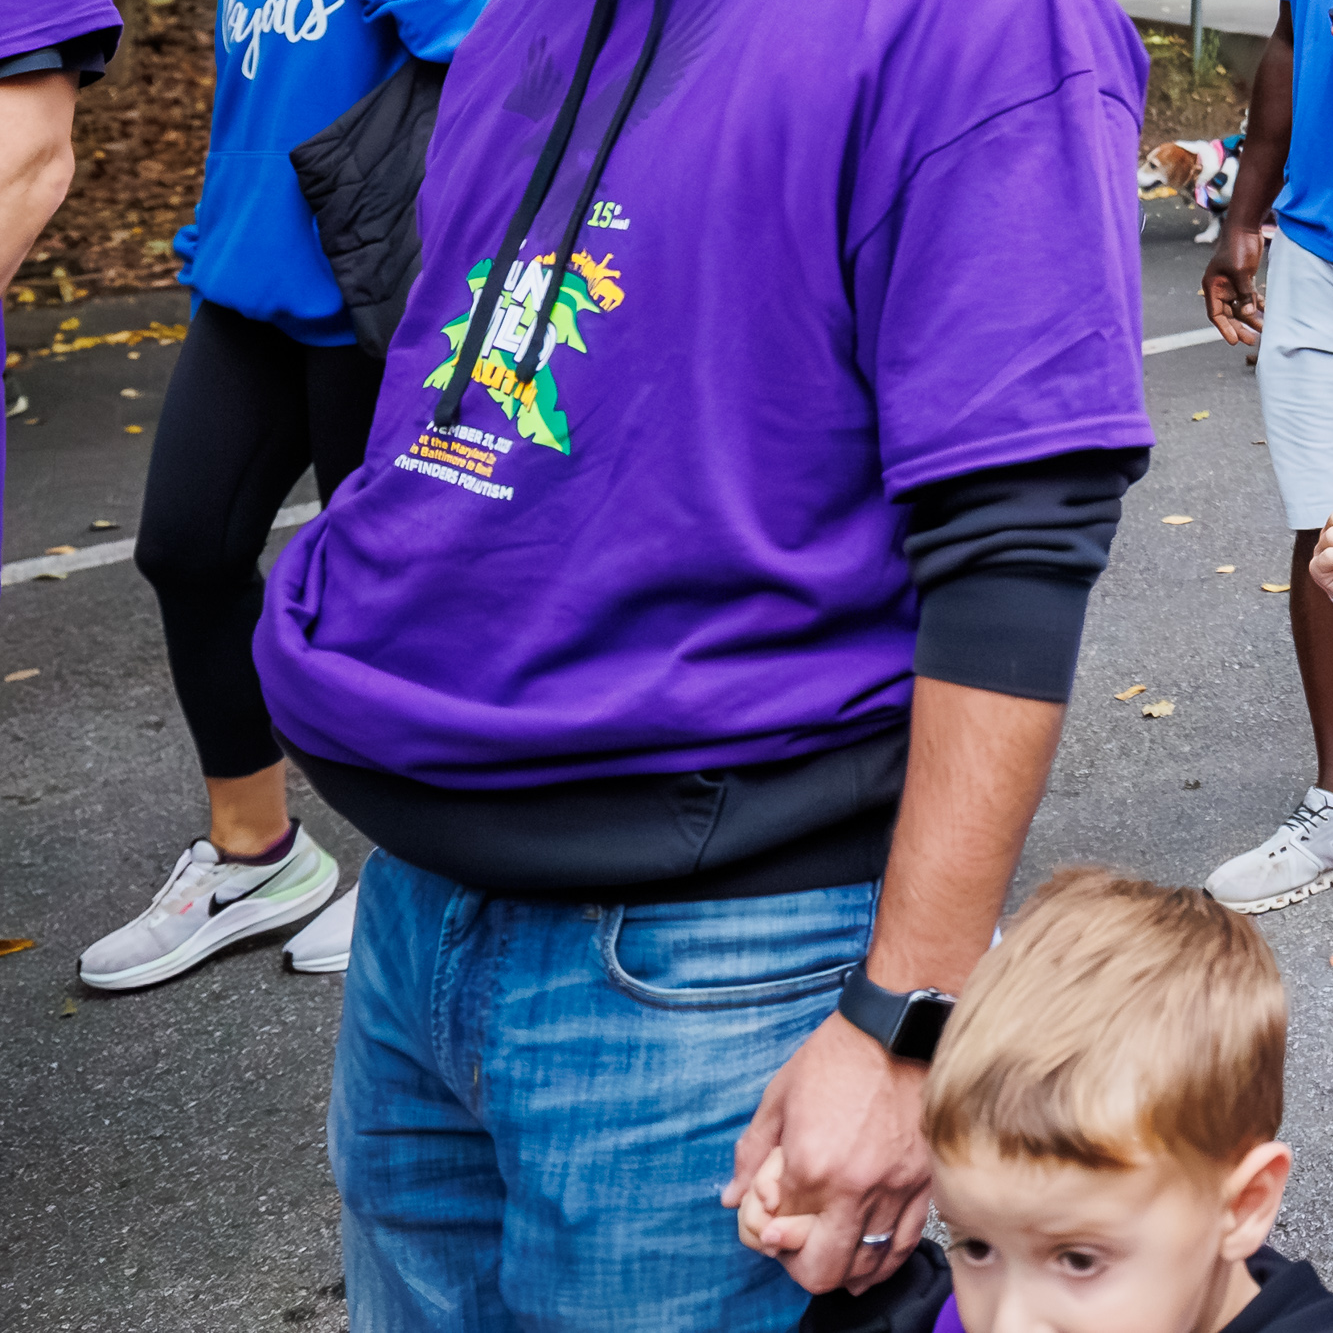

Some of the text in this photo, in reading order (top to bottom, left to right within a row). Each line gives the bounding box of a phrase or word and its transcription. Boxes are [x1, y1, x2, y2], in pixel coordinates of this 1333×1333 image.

[587, 201, 615, 228] 15
[503, 239, 553, 312] UN
[431, 437, 448, 449] the
